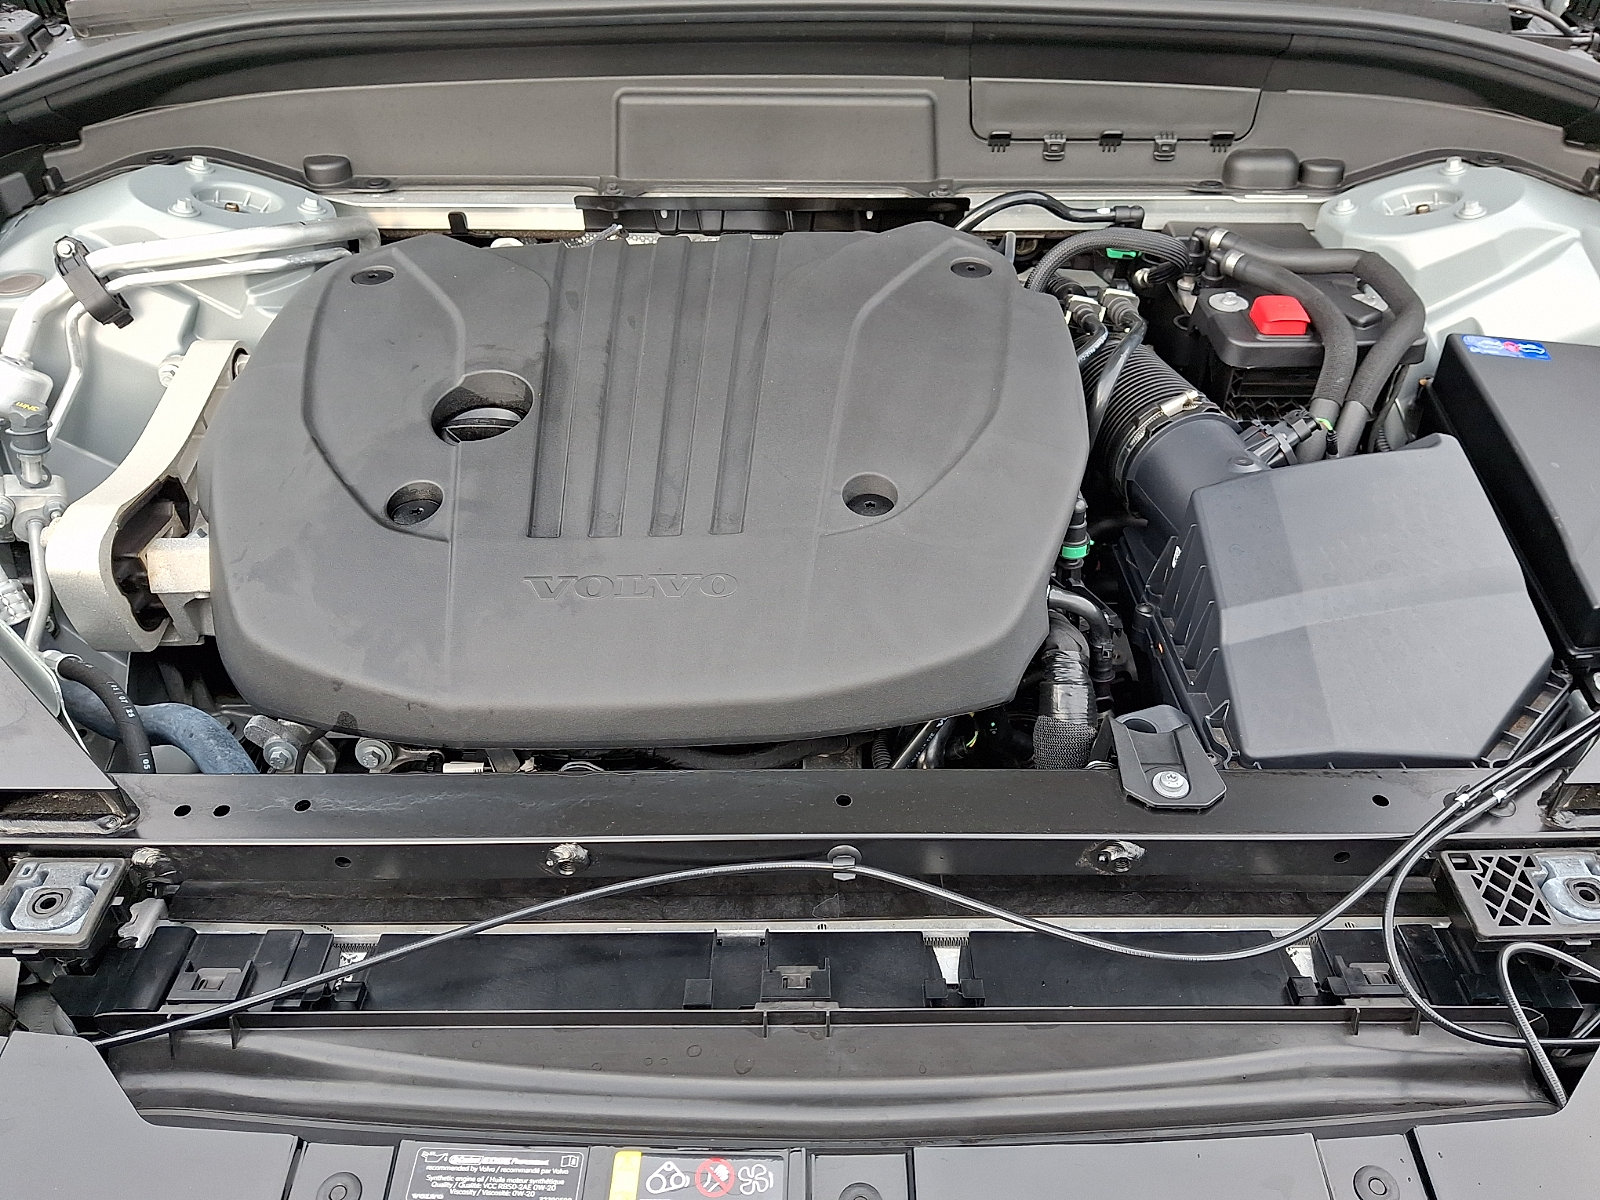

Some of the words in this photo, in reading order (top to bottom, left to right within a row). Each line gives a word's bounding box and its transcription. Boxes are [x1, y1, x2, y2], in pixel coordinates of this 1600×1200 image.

[521, 573, 738, 600] VOLVO
[142, 758, 151, 770] 05
[425, 1174, 455, 1182] Synthetic
[449, 1188, 477, 1196] Viscosity
[532, 1184, 557, 1192] 0W-20
